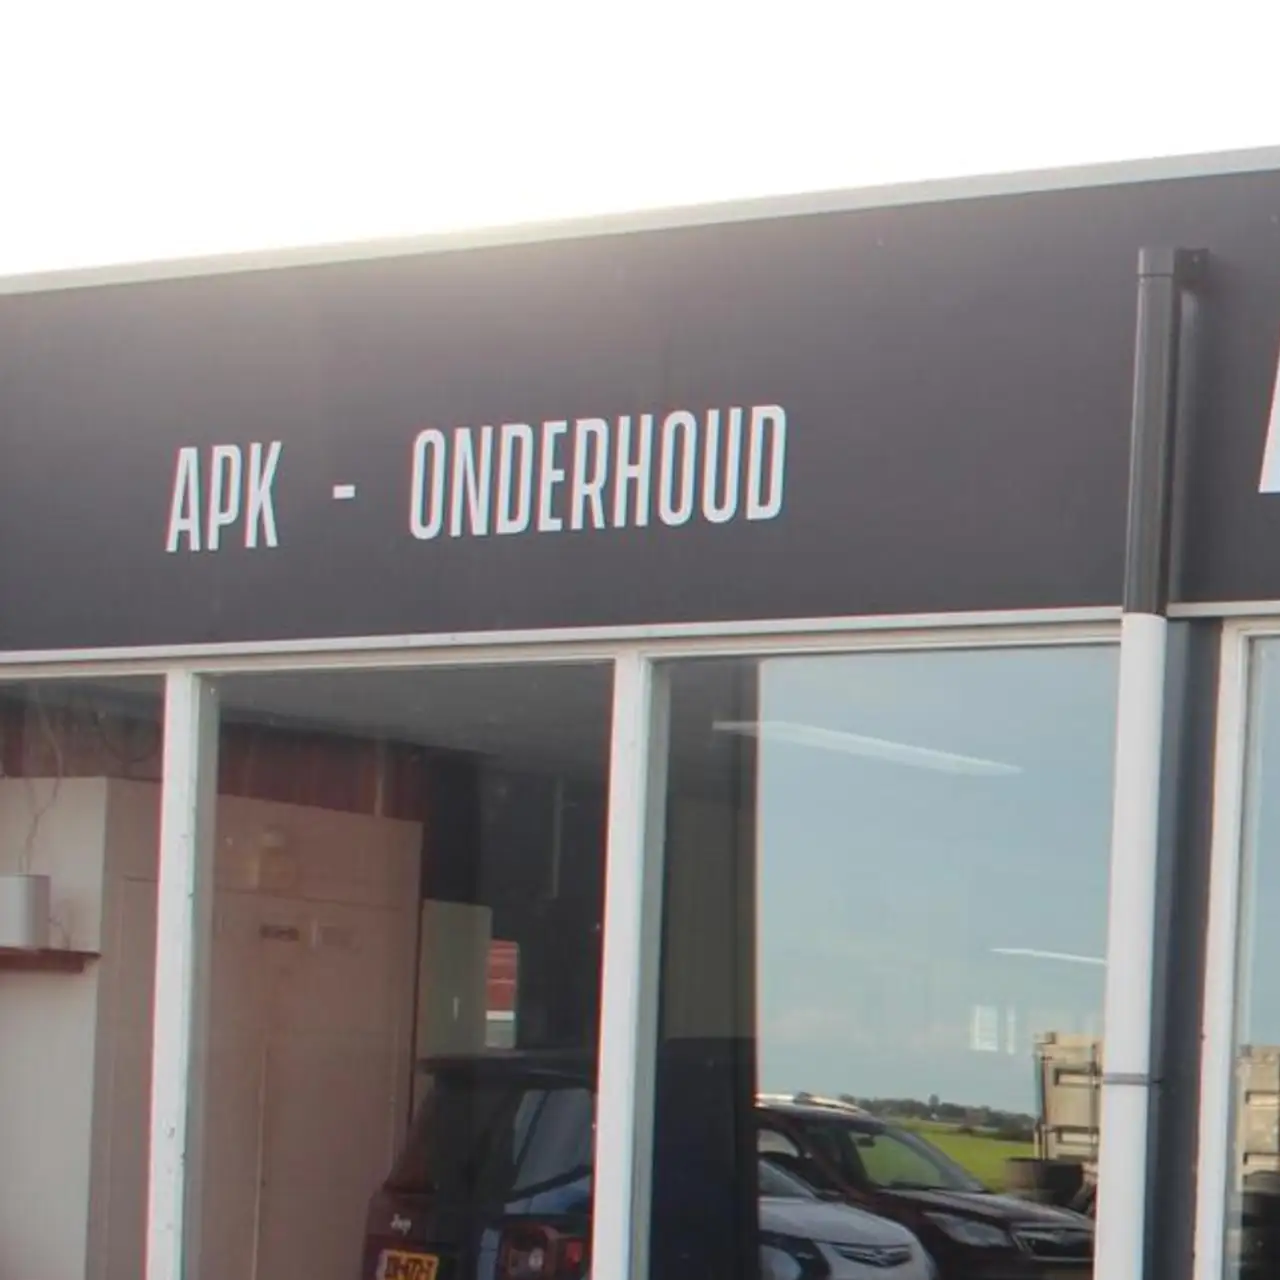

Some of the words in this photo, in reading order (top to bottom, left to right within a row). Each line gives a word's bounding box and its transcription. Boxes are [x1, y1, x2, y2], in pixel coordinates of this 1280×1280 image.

[166, 441, 282, 552] APK
[333, 485, 355, 498] -
[410, 405, 786, 540] ONDERHOUD
